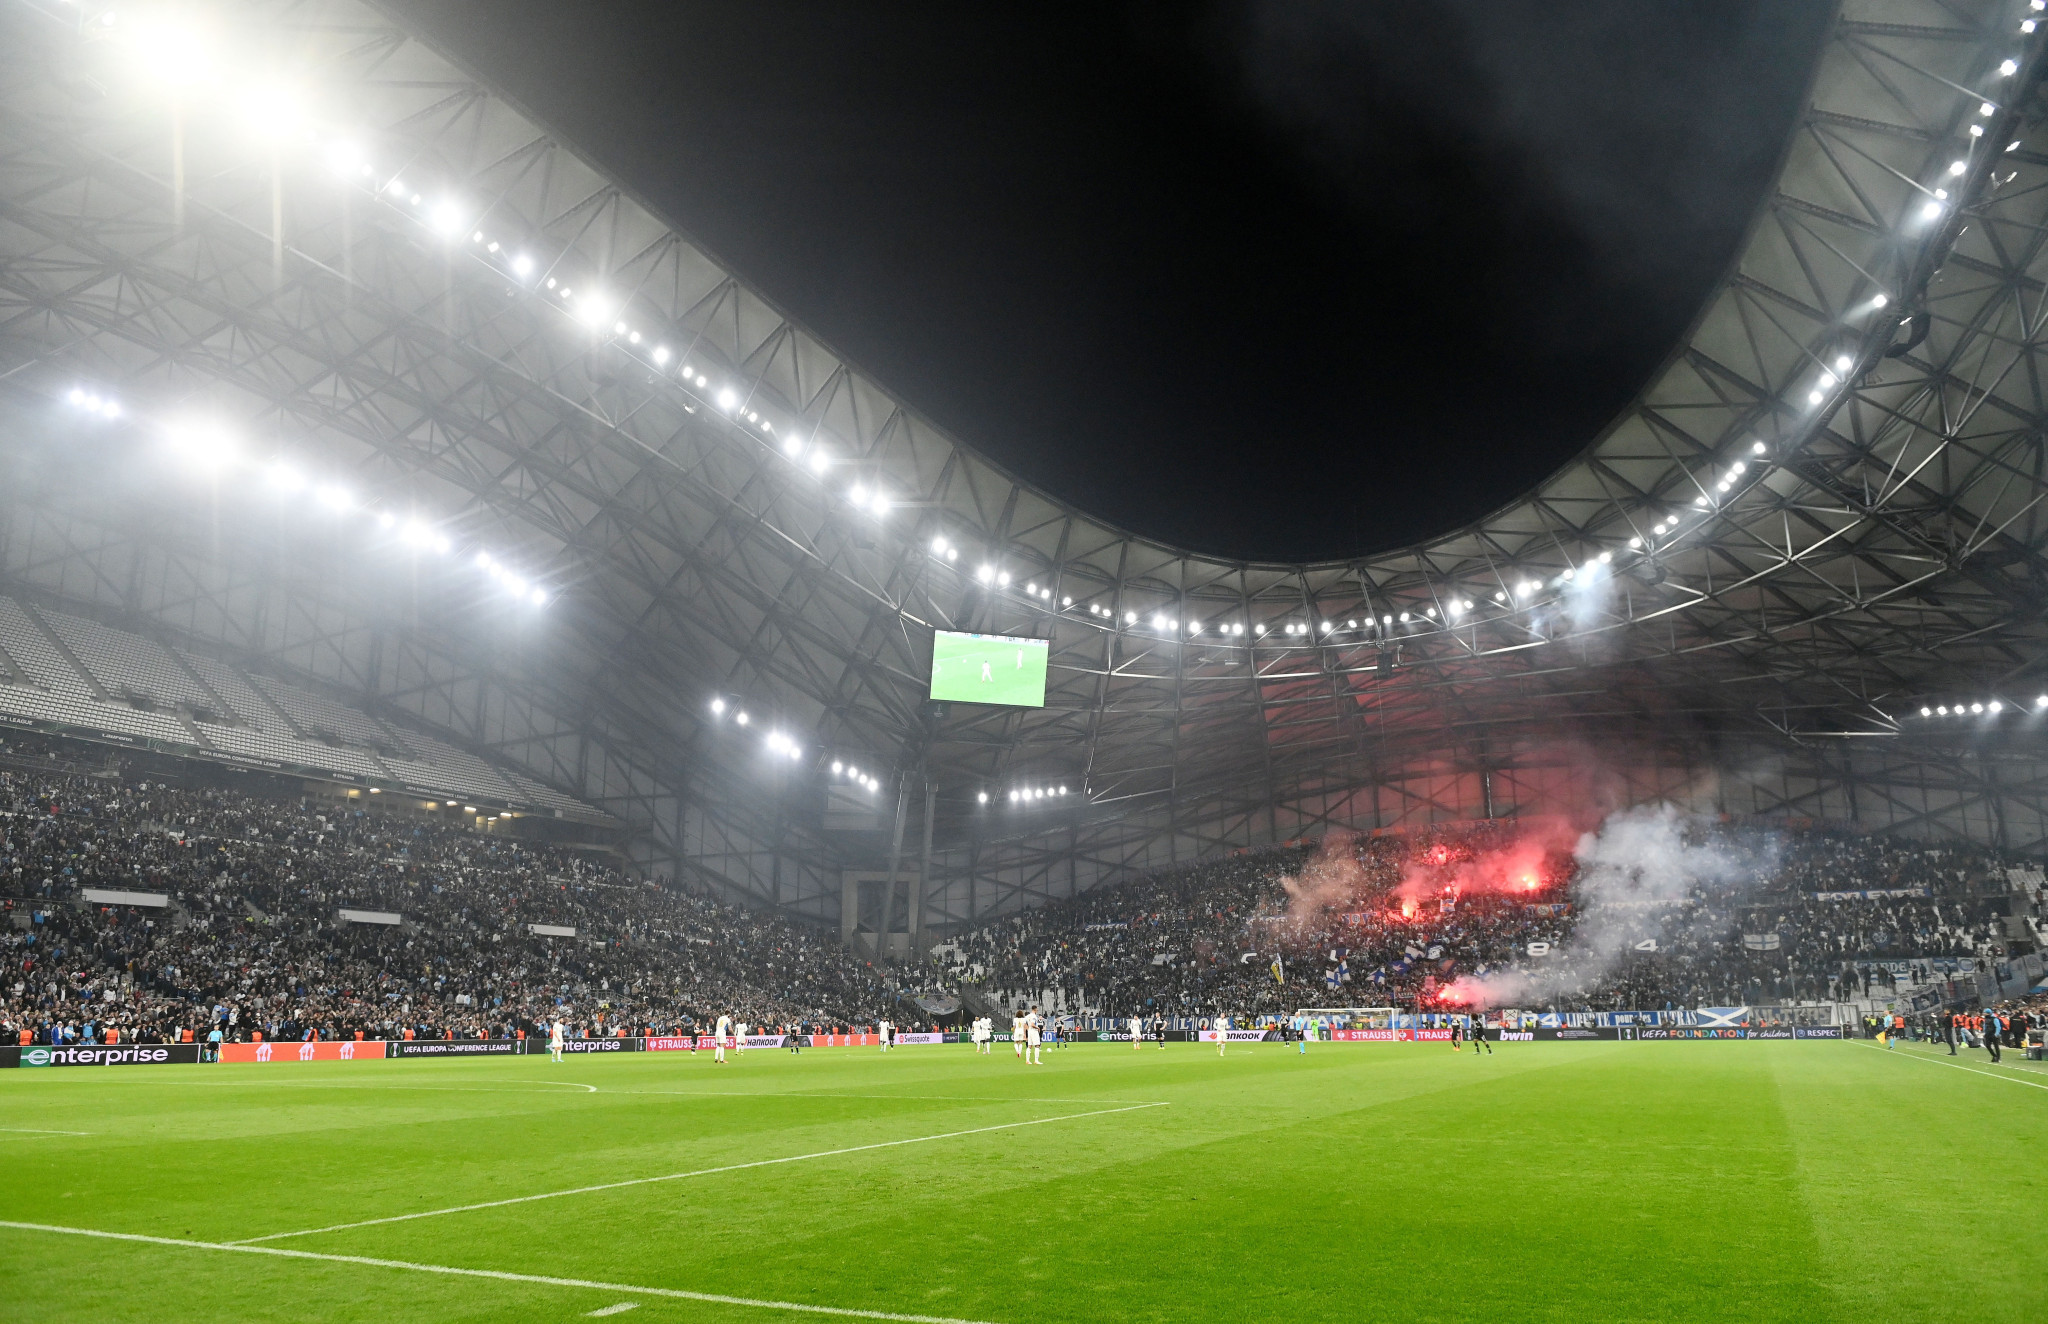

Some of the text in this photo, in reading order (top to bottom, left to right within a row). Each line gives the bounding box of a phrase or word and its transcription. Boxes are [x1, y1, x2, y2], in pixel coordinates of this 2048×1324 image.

[212, 752, 232, 760] EUROPA
[231, 755, 263, 766] CONFERENCE
[1351, 1031, 1393, 1040] STRAUSS
[1500, 1029, 1534, 1041] bwin
[1641, 1028, 1791, 1040] UEFA FOUNDATION for children
[403, 1045, 422, 1053] UEFA
[422, 1044, 447, 1053] EUROPA
[21, 1045, 169, 1066] enterprise
